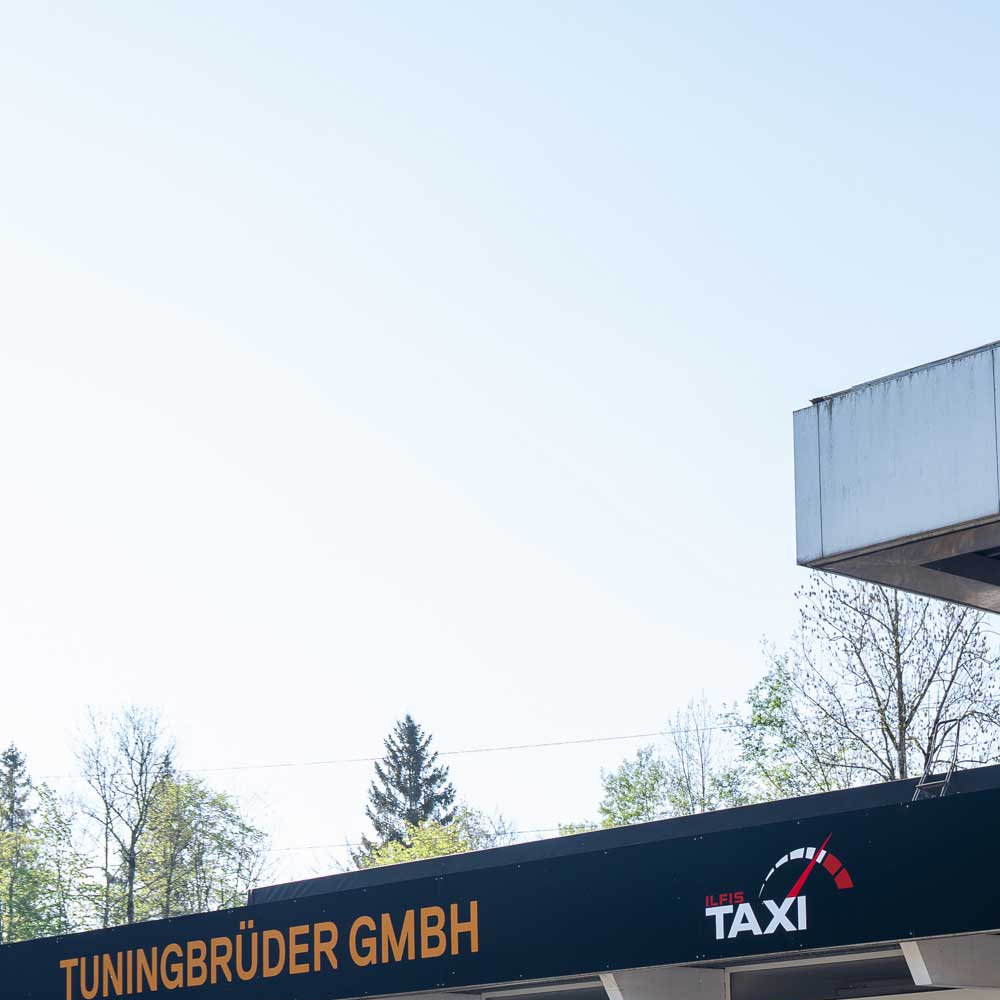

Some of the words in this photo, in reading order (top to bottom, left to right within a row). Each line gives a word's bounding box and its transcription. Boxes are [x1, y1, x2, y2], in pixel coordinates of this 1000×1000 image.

[705, 891, 745, 907] ILFIS
[705, 895, 807, 940] TAXI
[348, 900, 480, 967] GMBH
